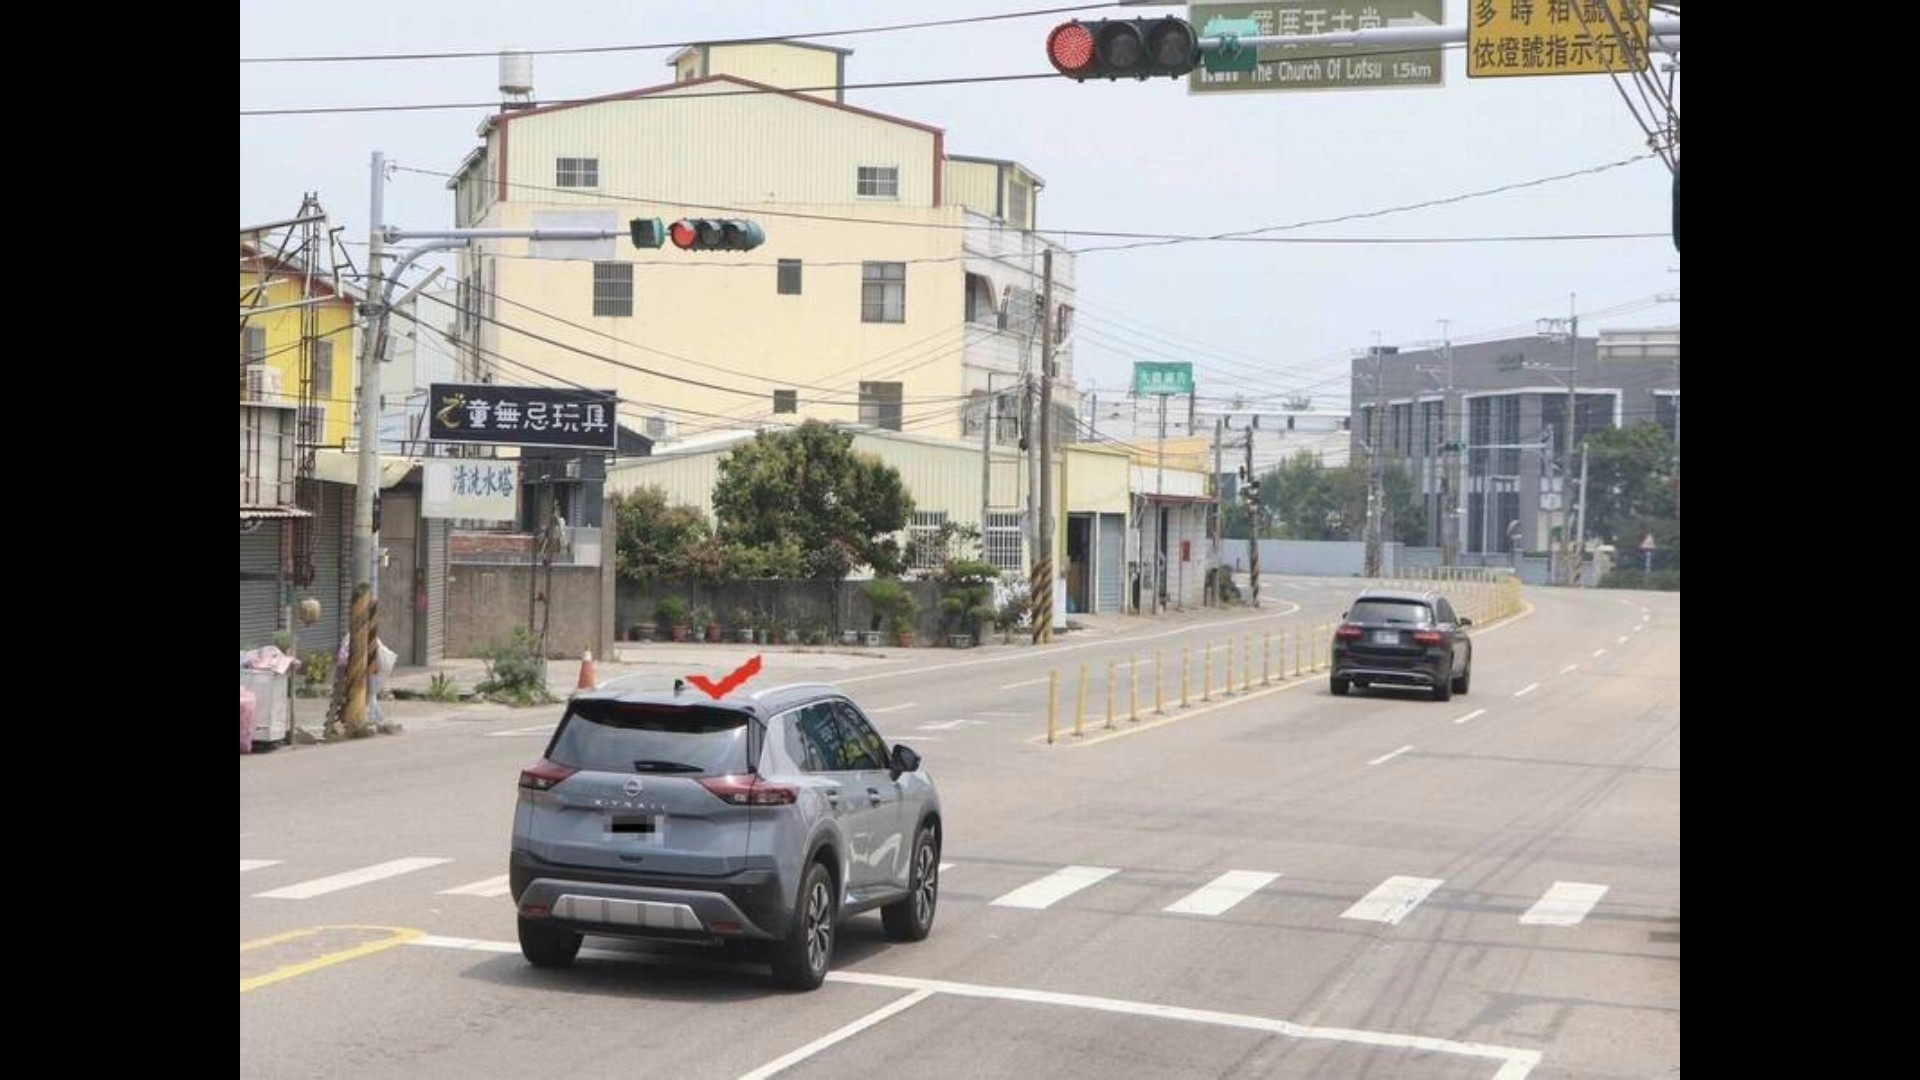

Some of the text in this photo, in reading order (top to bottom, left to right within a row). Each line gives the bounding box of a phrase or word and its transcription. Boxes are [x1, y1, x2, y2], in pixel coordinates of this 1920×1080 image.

[1279, 60, 1321, 81] Church
[1346, 58, 1382, 80] Lotsu
[466, 398, 608, 433] 童無忌玩具
[453, 464, 514, 497] 清洗水塔
